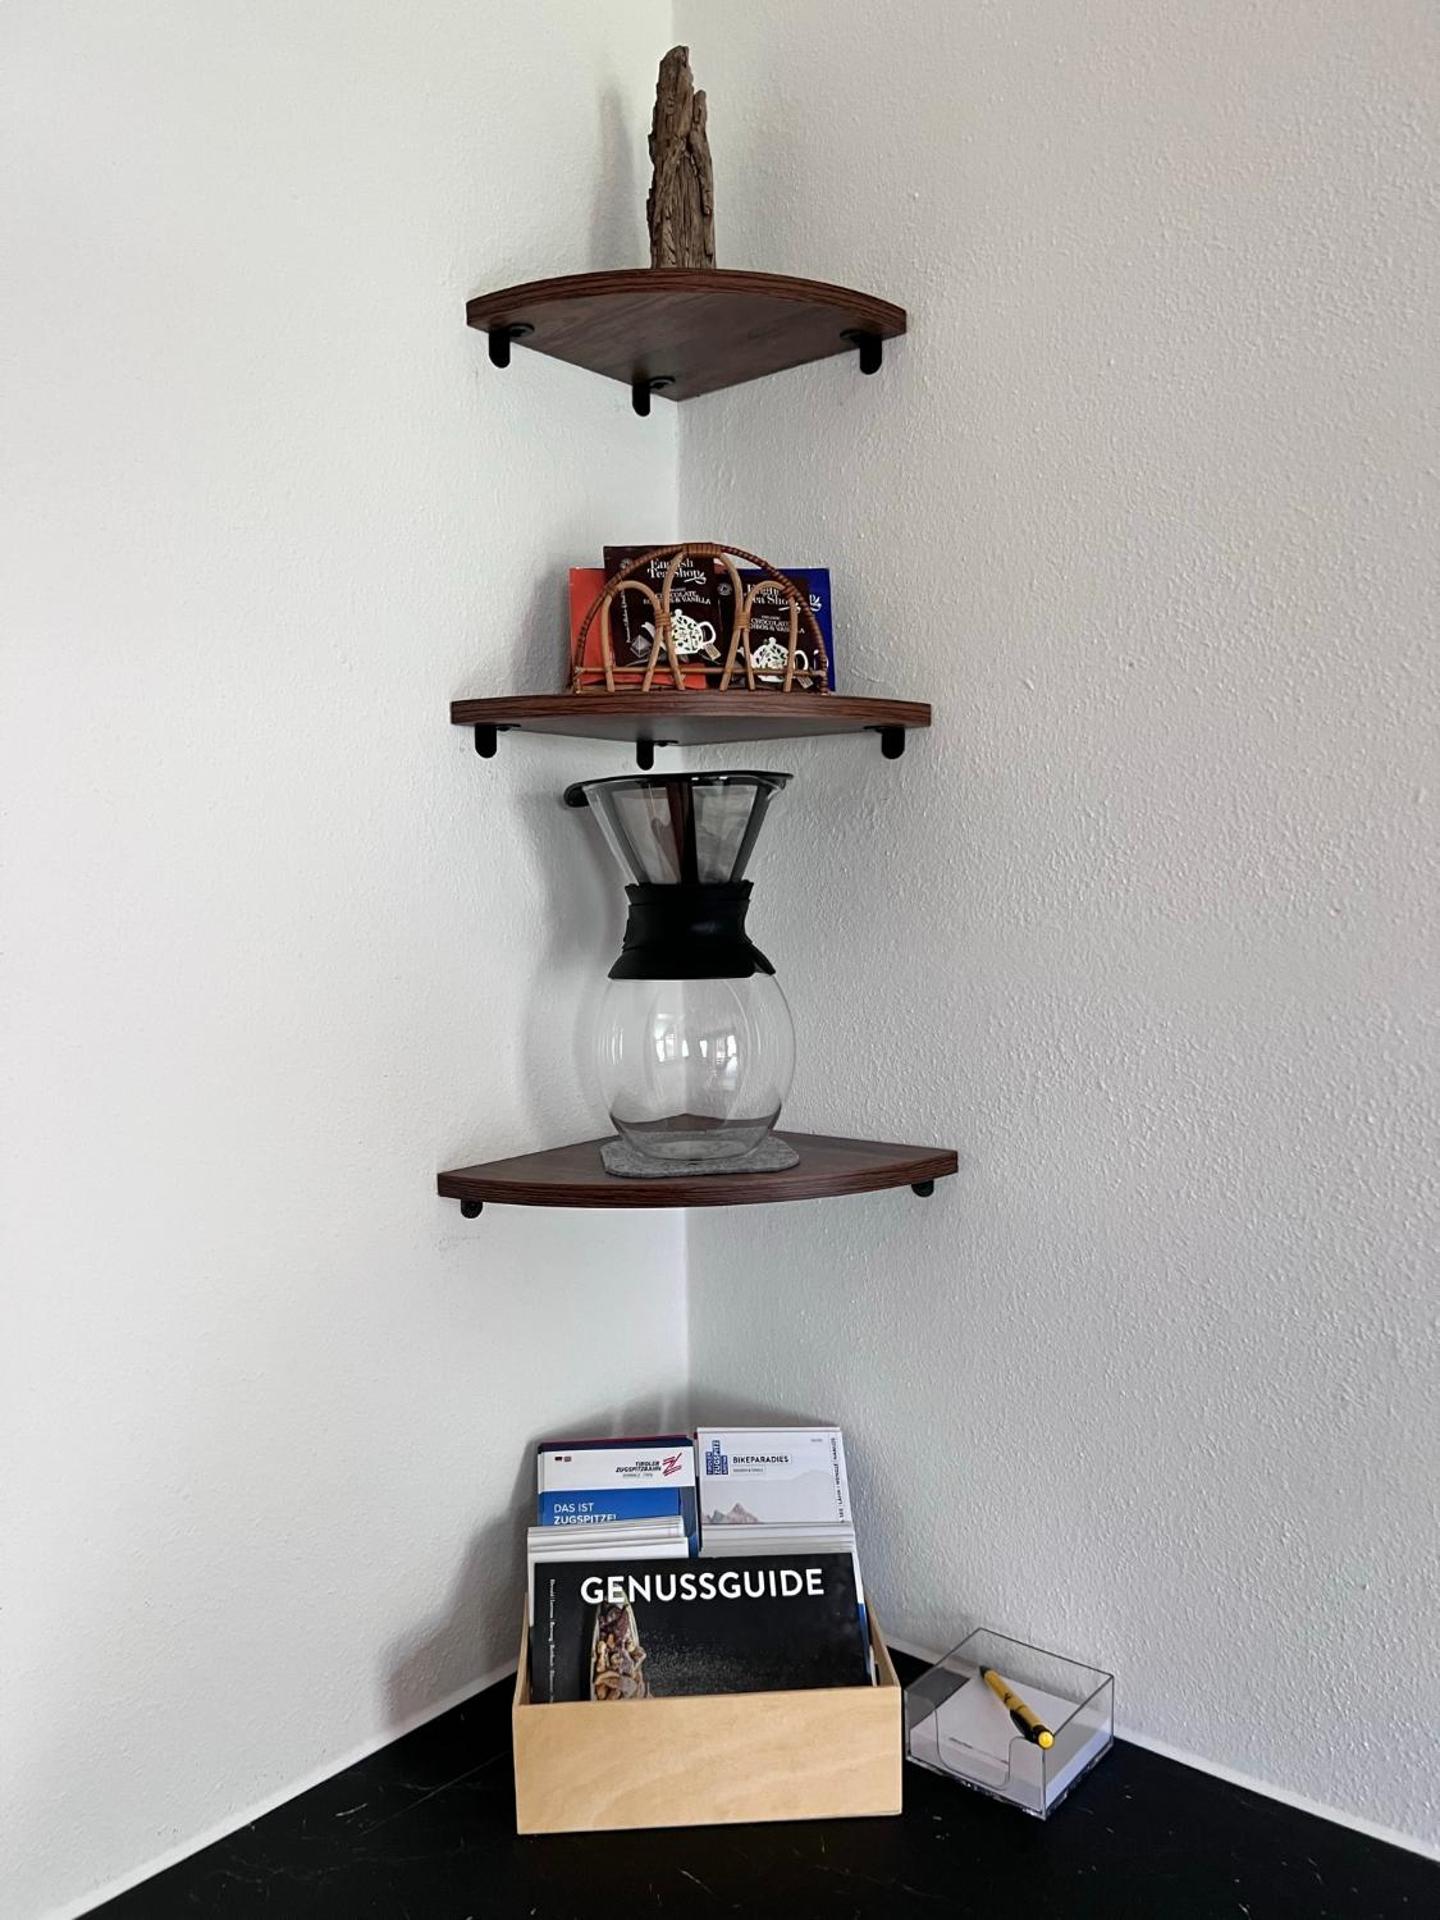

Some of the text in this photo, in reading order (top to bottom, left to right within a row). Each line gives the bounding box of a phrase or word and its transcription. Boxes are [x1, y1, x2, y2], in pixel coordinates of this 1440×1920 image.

[732, 1455, 790, 1464] BIKEPARADIES
[553, 1502, 595, 1514] DAS IST
[580, 1568, 825, 1605] GENUSSGUIDE
